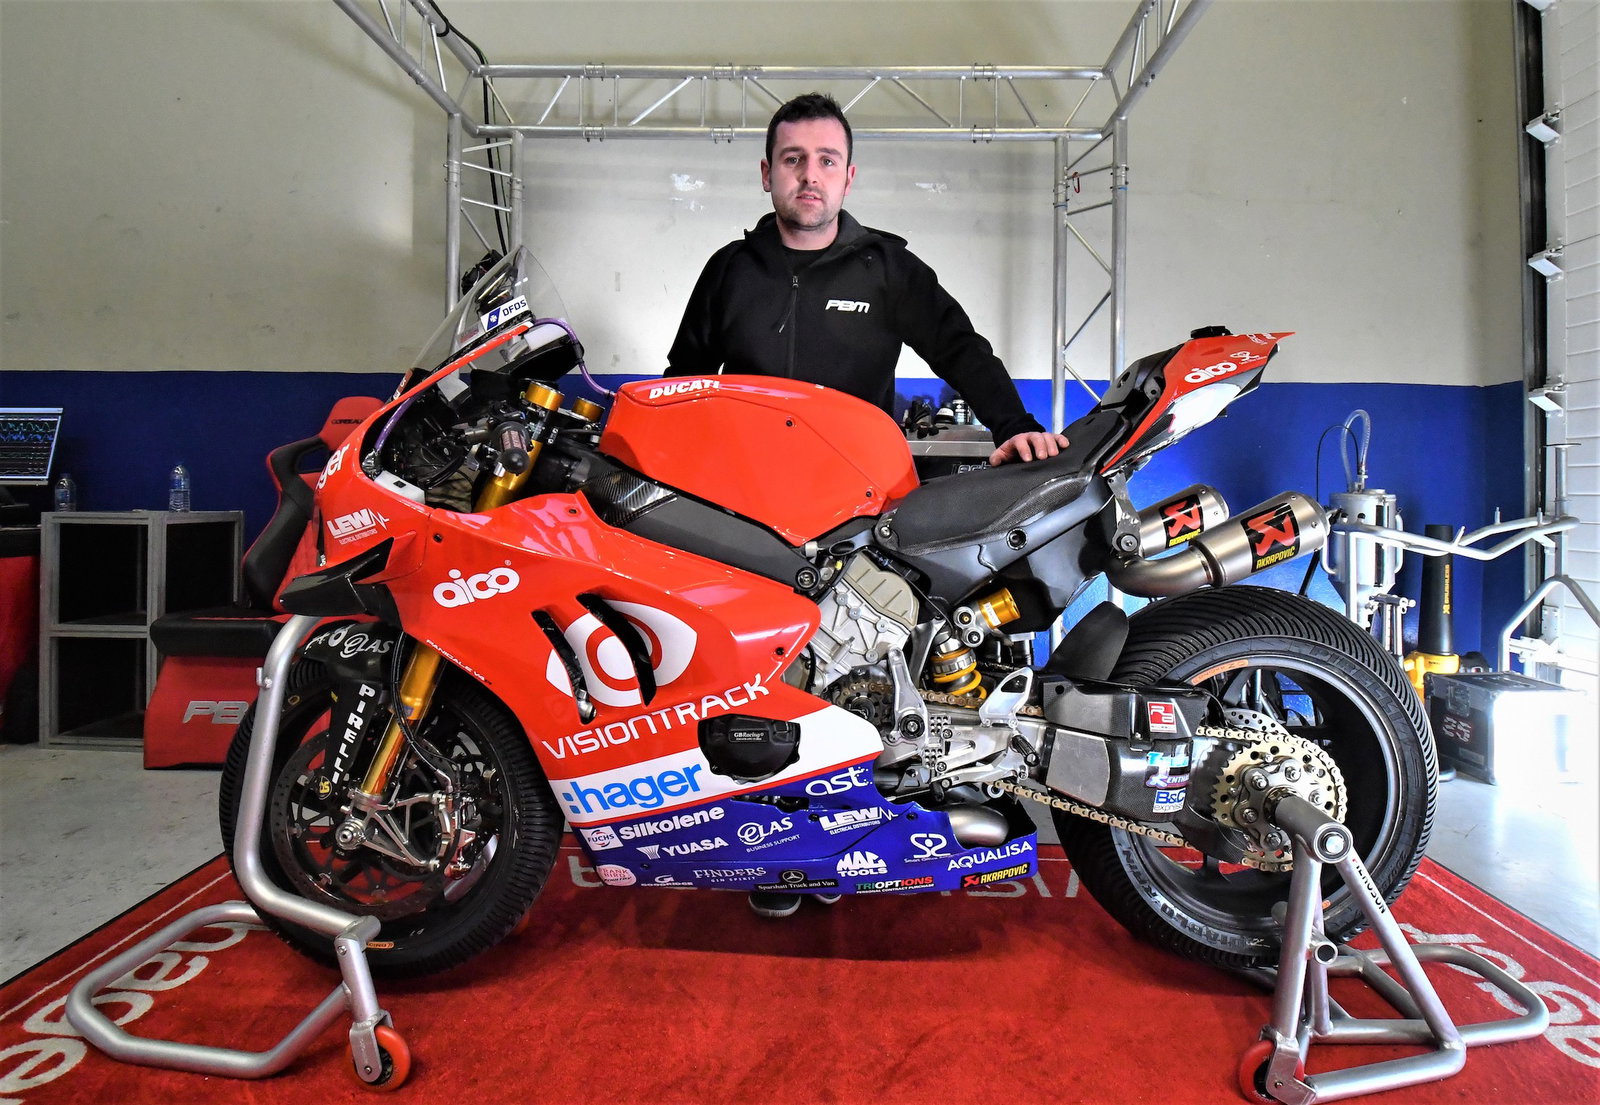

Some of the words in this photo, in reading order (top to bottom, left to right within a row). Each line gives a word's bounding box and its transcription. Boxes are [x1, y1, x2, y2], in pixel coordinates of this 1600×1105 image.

[502, 299, 527, 317] DFDS
[825, 299, 870, 314] PBM
[1184, 361, 1237, 383] aico
[649, 379, 720, 399] DUCATI
[326, 508, 372, 537] LEW
[1256, 546, 1296, 570] AKRAPOVIC
[433, 567, 521, 608] aico
[182, 700, 250, 725] PB
[542, 673, 769, 759] VISIONTRACK
[333, 683, 376, 784] PIRELLI
[619, 806, 725, 840] Silkolene
[819, 807, 879, 830] LEW
[587, 833, 615, 843] FUCHS
[662, 836, 729, 857] YUASA
[746, 842, 773, 853] BUSINESS
[773, 834, 801, 846] SUPPORT
[836, 851, 887, 871] MAC
[948, 840, 1033, 871] AQUALISA
[693, 867, 767, 879] FINDERS
[837, 866, 888, 877] TOOLS
[980, 863, 1028, 884] AKRAPOVIC
[856, 876, 933, 890] TRIOPTIONS
